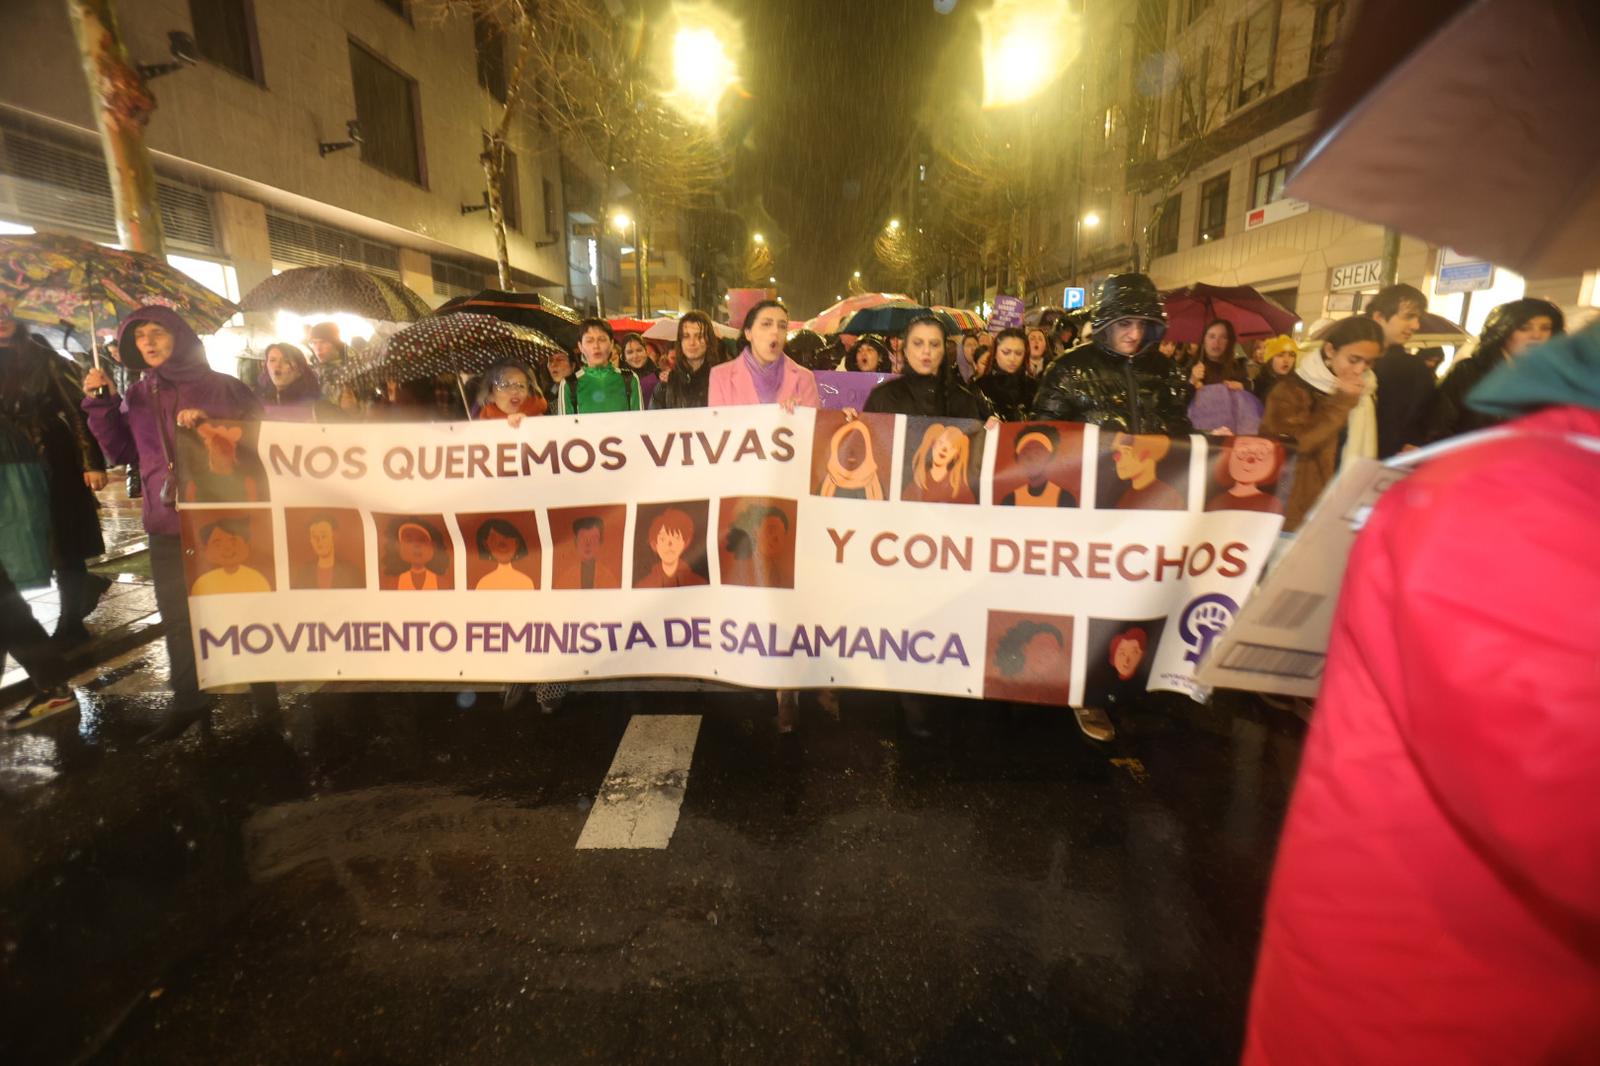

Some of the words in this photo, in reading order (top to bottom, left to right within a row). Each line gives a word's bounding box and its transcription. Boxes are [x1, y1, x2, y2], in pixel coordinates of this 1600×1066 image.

[1067, 290, 1081, 308] P
[268, 443, 368, 480] NOS
[382, 438, 627, 481] QUEREMOS
[641, 427, 796, 467] VIVAS
[826, 527, 856, 563] Y
[870, 531, 973, 571] CON
[989, 538, 1249, 582] DERECHOS
[199, 621, 458, 660] MOVIMIENTO
[465, 619, 656, 654] FEMINISTA
[664, 617, 711, 649] DE
[720, 618, 970, 667] SALAMANCA
